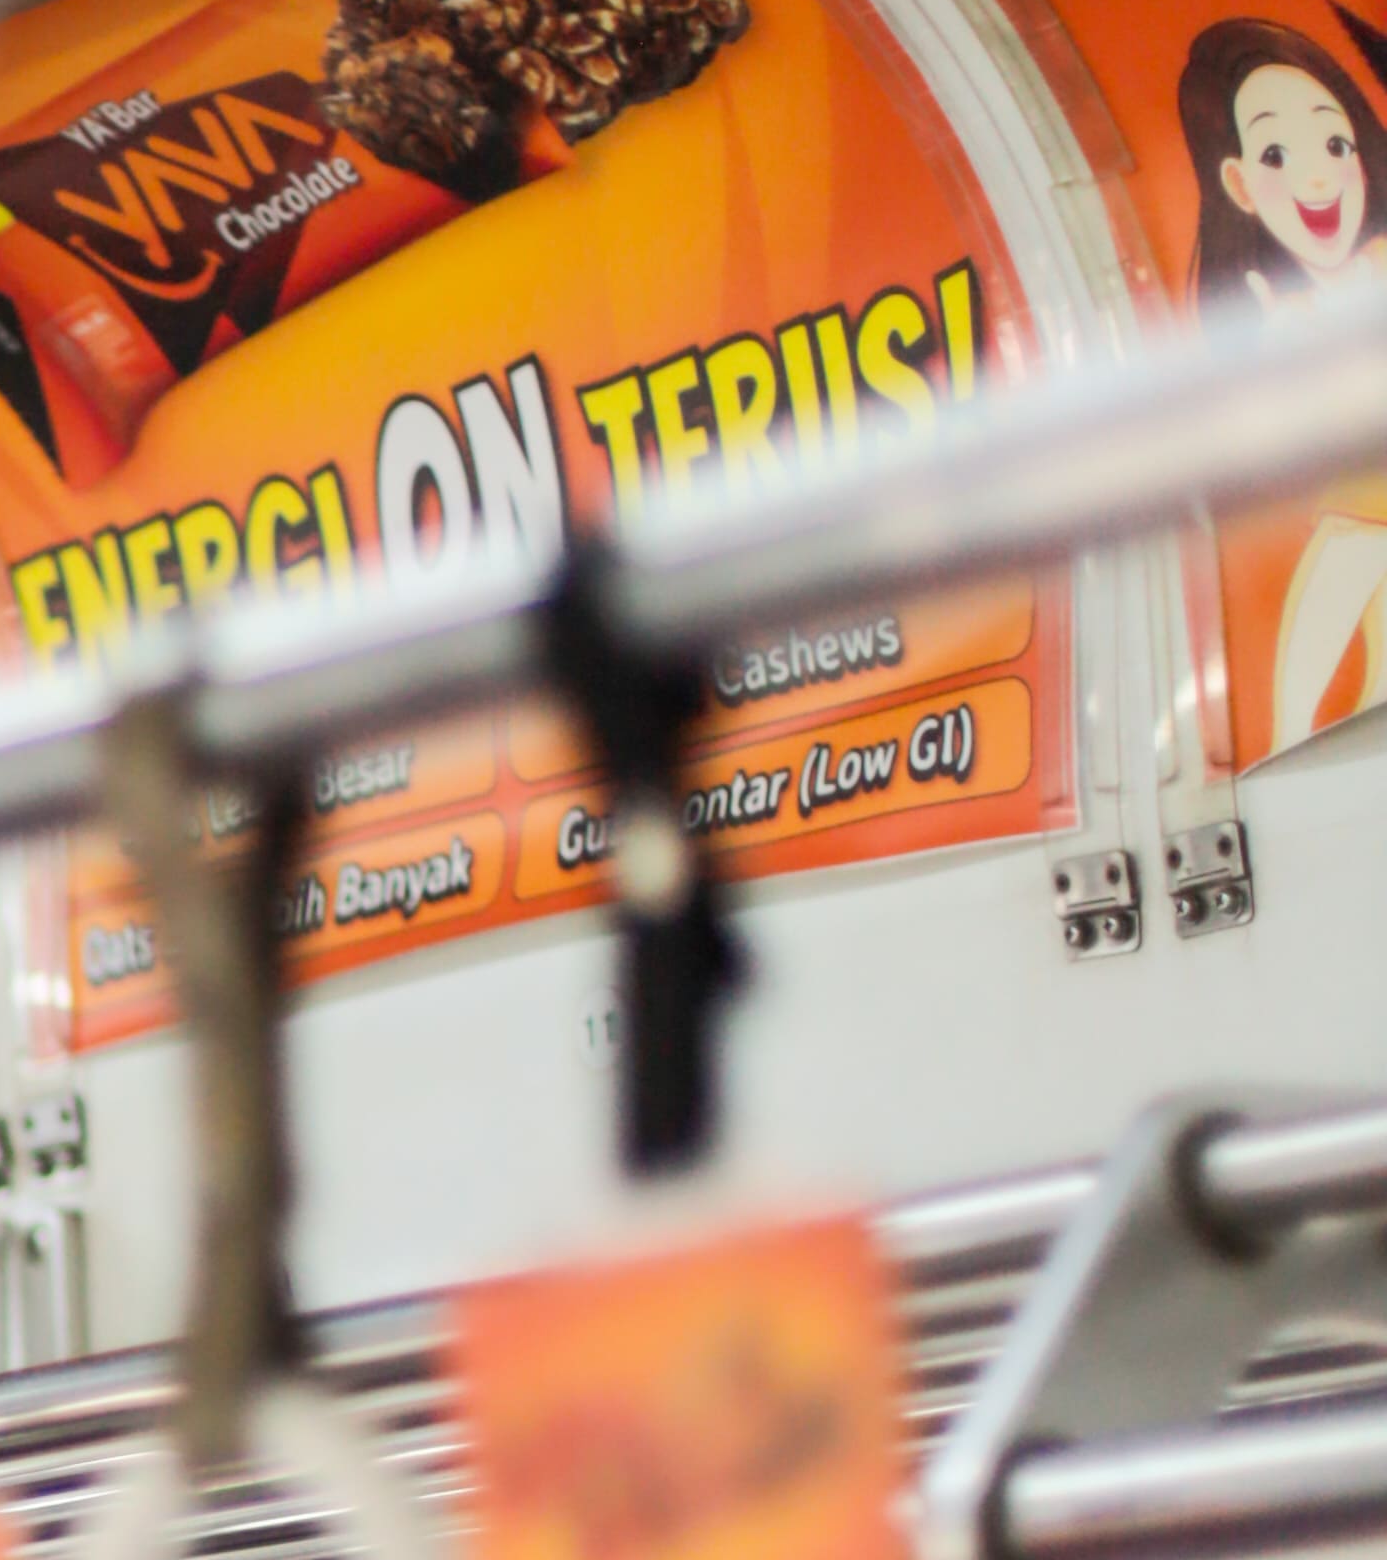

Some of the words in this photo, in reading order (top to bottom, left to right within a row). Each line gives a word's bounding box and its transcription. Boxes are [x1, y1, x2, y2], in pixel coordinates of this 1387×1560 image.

[215, 155, 360, 250] Chocolate
[374, 355, 569, 605] ON
[712, 616, 902, 698] Cashews
[683, 766, 793, 830] ontar
[797, 743, 899, 810] (Low
[908, 705, 977, 775] GI)
[334, 837, 473, 917] Banyak
